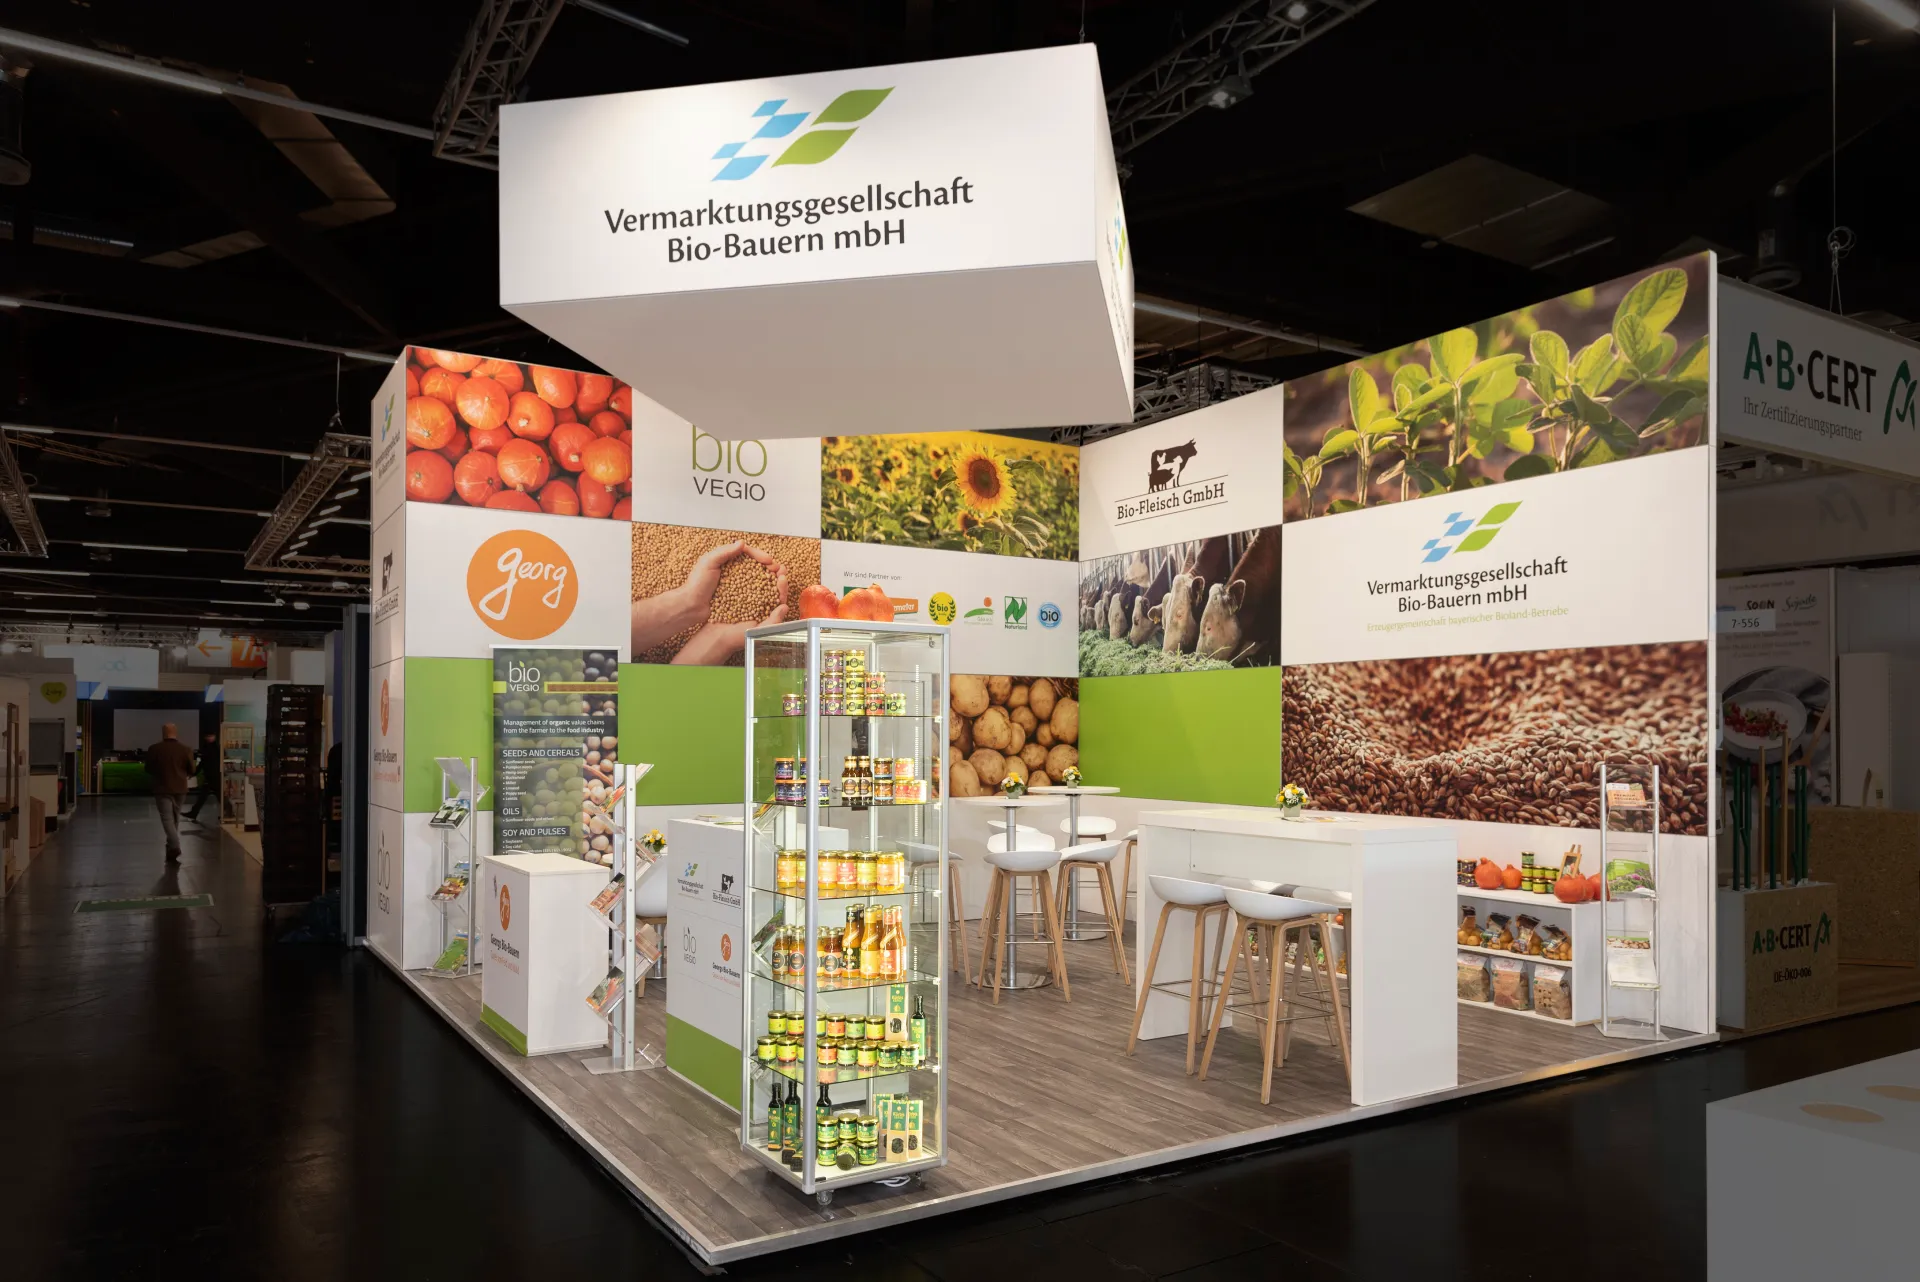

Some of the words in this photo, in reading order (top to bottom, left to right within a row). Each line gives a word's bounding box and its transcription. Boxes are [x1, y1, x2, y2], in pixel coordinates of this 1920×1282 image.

[604, 177, 974, 235] Vermarktungsgesellschaft
[667, 232, 825, 263] Bio-Bauern
[833, 219, 906, 249] mbH
[1744, 396, 1758, 415] Ihr
[1761, 401, 1862, 442] Zertifizierungspartner
[693, 476, 766, 501] VEGIO
[1117, 492, 1180, 520] Bio-Fleisch
[1183, 482, 1225, 505] GmbH
[479, 548, 569, 621] georg
[1367, 556, 1568, 596] Vermarktungsgesellschaft
[936, 603, 949, 612] bio
[1398, 593, 1481, 613] Bio-Bauern
[1486, 584, 1527, 604] mbH
[1040, 609, 1059, 622] bio
[1367, 616, 1446, 632] Erzeugergemeinschaft
[1448, 614, 1493, 628] bayerischer
[1495, 607, 1568, 621] Bioland-Betriebe
[1731, 617, 1760, 628] 7-556
[509, 660, 541, 683] bio
[509, 684, 540, 692] VEGIO
[503, 719, 541, 727] Management
[549, 719, 570, 727] organic
[502, 749, 528, 757] SEEDS
[529, 749, 546, 757] AND
[547, 748, 580, 757] CEREALS
[502, 808, 520, 816] OILS
[502, 829, 518, 837] SOY
[537, 828, 567, 836] PULSES
[1773, 966, 1812, 983] DE-ÖKO-006
